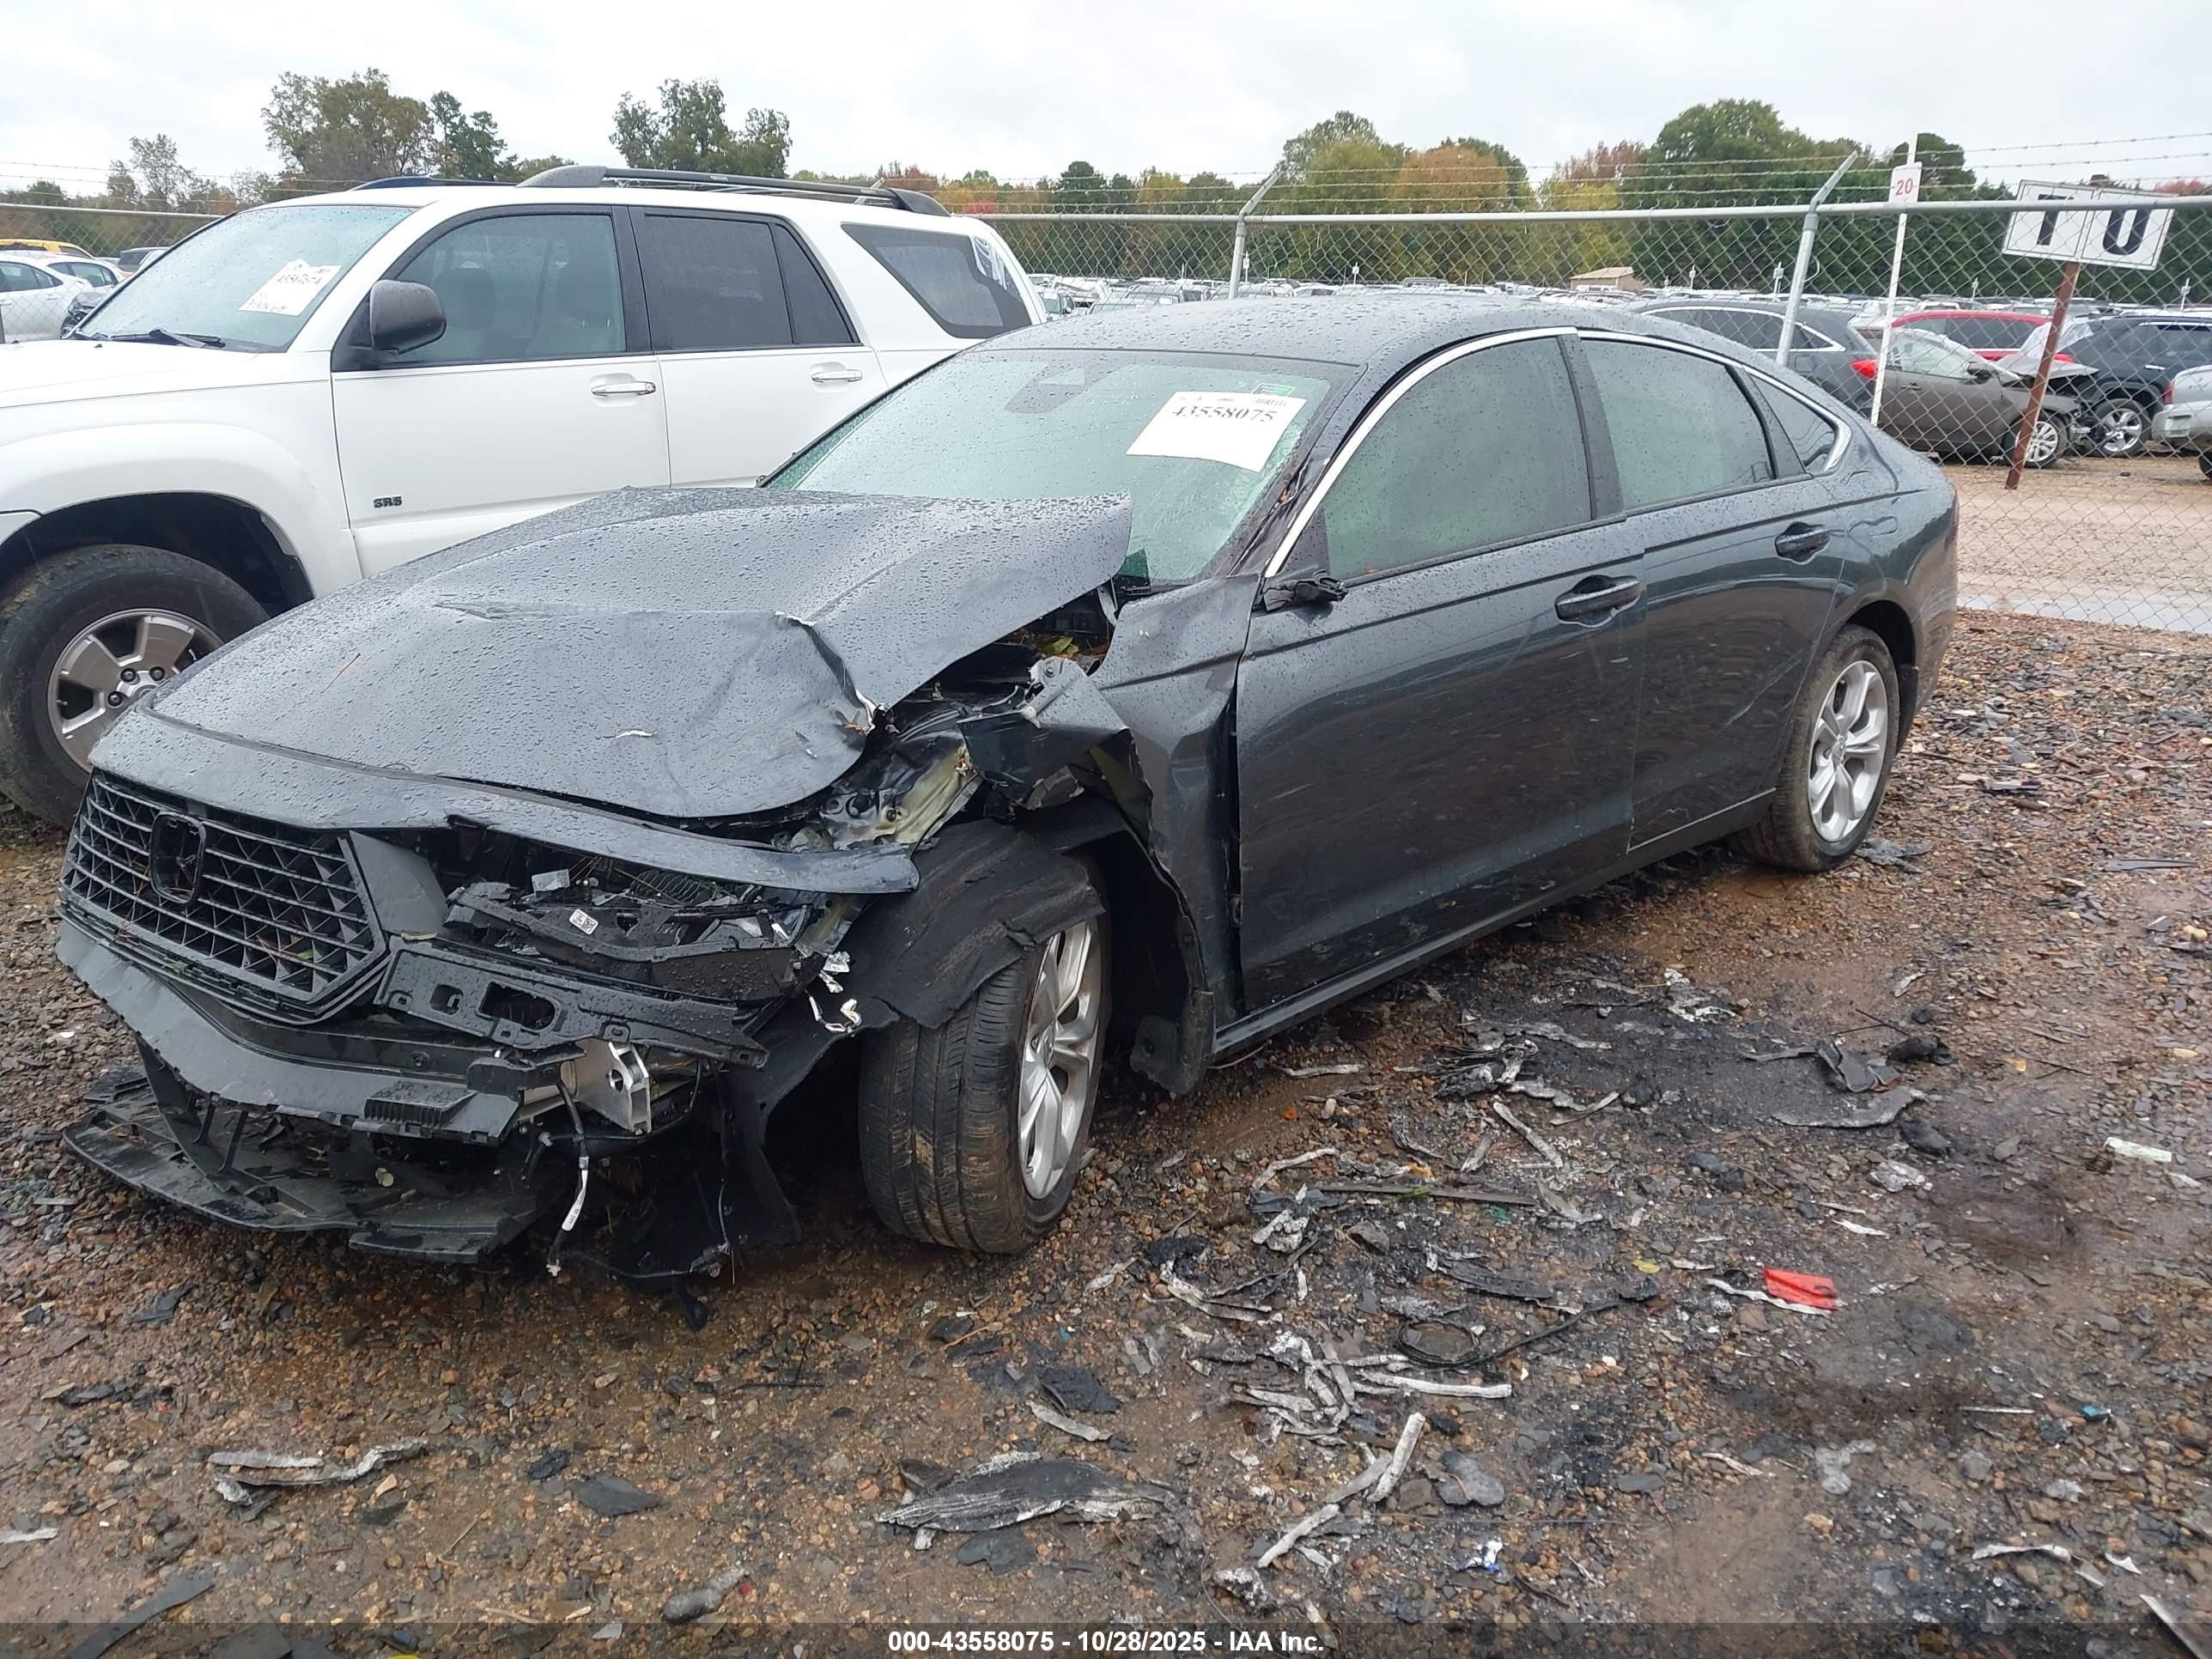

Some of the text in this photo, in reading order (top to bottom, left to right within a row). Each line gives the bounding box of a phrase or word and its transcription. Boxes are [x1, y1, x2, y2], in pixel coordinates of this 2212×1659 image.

[1895, 178, 1914, 197] 20
[1171, 404, 1279, 422] 43558075
[373, 495, 403, 508] SR5
